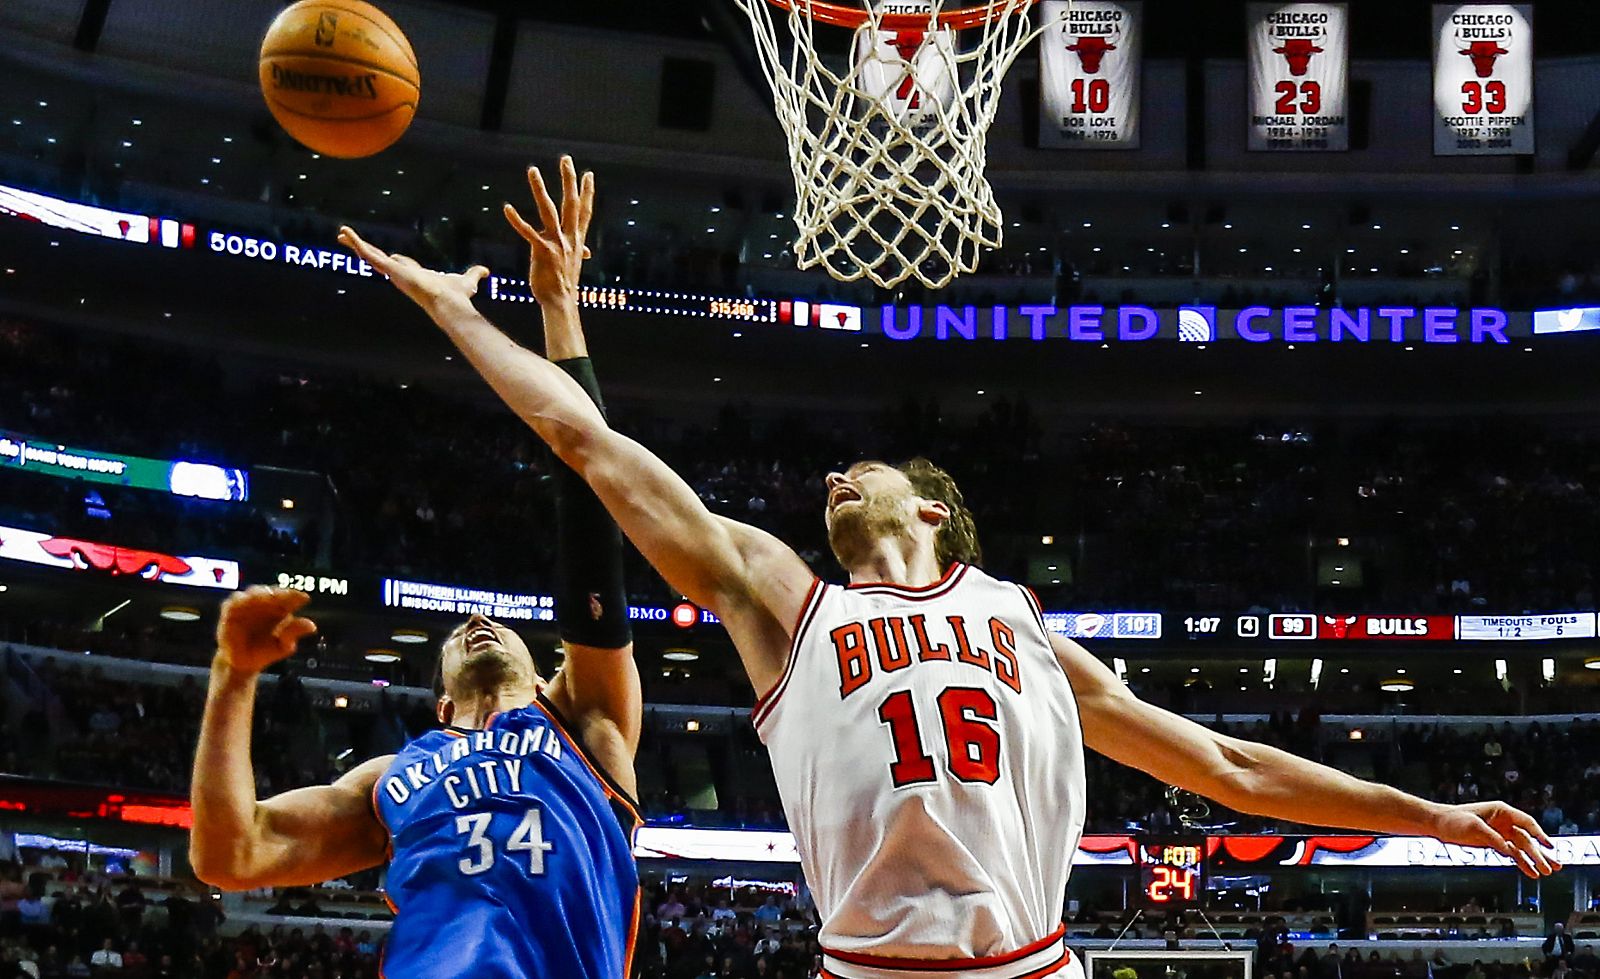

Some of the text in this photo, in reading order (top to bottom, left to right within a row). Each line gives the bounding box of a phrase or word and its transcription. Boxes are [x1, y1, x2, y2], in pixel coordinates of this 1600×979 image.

[1061, 10, 1122, 22] CHICAGO
[1267, 13, 1328, 25] CHICAGO
[1452, 14, 1513, 26] CHICAGO
[1069, 23, 1113, 34] BULLS
[1276, 26, 1320, 37] BULLS
[1463, 27, 1505, 38] BULLS
[272, 61, 377, 99] SPALDING
[1071, 78, 1110, 113] 10
[1274, 80, 1321, 115] 23
[1461, 80, 1506, 115] 33
[1063, 117, 1116, 128] BOB LOVE
[1444, 116, 1525, 127] SCOTTIE PIPPEN
[210, 232, 373, 277] 5050 RAFFLE
[577, 290, 626, 306] 10435
[882, 306, 1509, 343] UNITED CENTER
[278, 572, 349, 595] 9:28 PM
[402, 581, 454, 600] SOUTHERN
[402, 595, 455, 613] MISSOURI
[457, 602, 493, 616] STATE
[494, 606, 533, 621] BEARS
[629, 606, 667, 620] BMO
[1125, 616, 1149, 633] 101
[1184, 616, 1221, 633] 1:07
[1243, 618, 1253, 632] 4
[1282, 617, 1305, 633] 99
[1366, 618, 1428, 636] BULLS
[1482, 616, 1578, 626] TIMEOUTS FOULS
[1556, 625, 1563, 636] 5
[829, 613, 1021, 700] BULLS
[877, 685, 1001, 788] 16
[386, 725, 562, 804] OKLAHOMA
[443, 758, 522, 809] CITY
[456, 808, 552, 876] 34
[1150, 867, 1192, 901] 24
